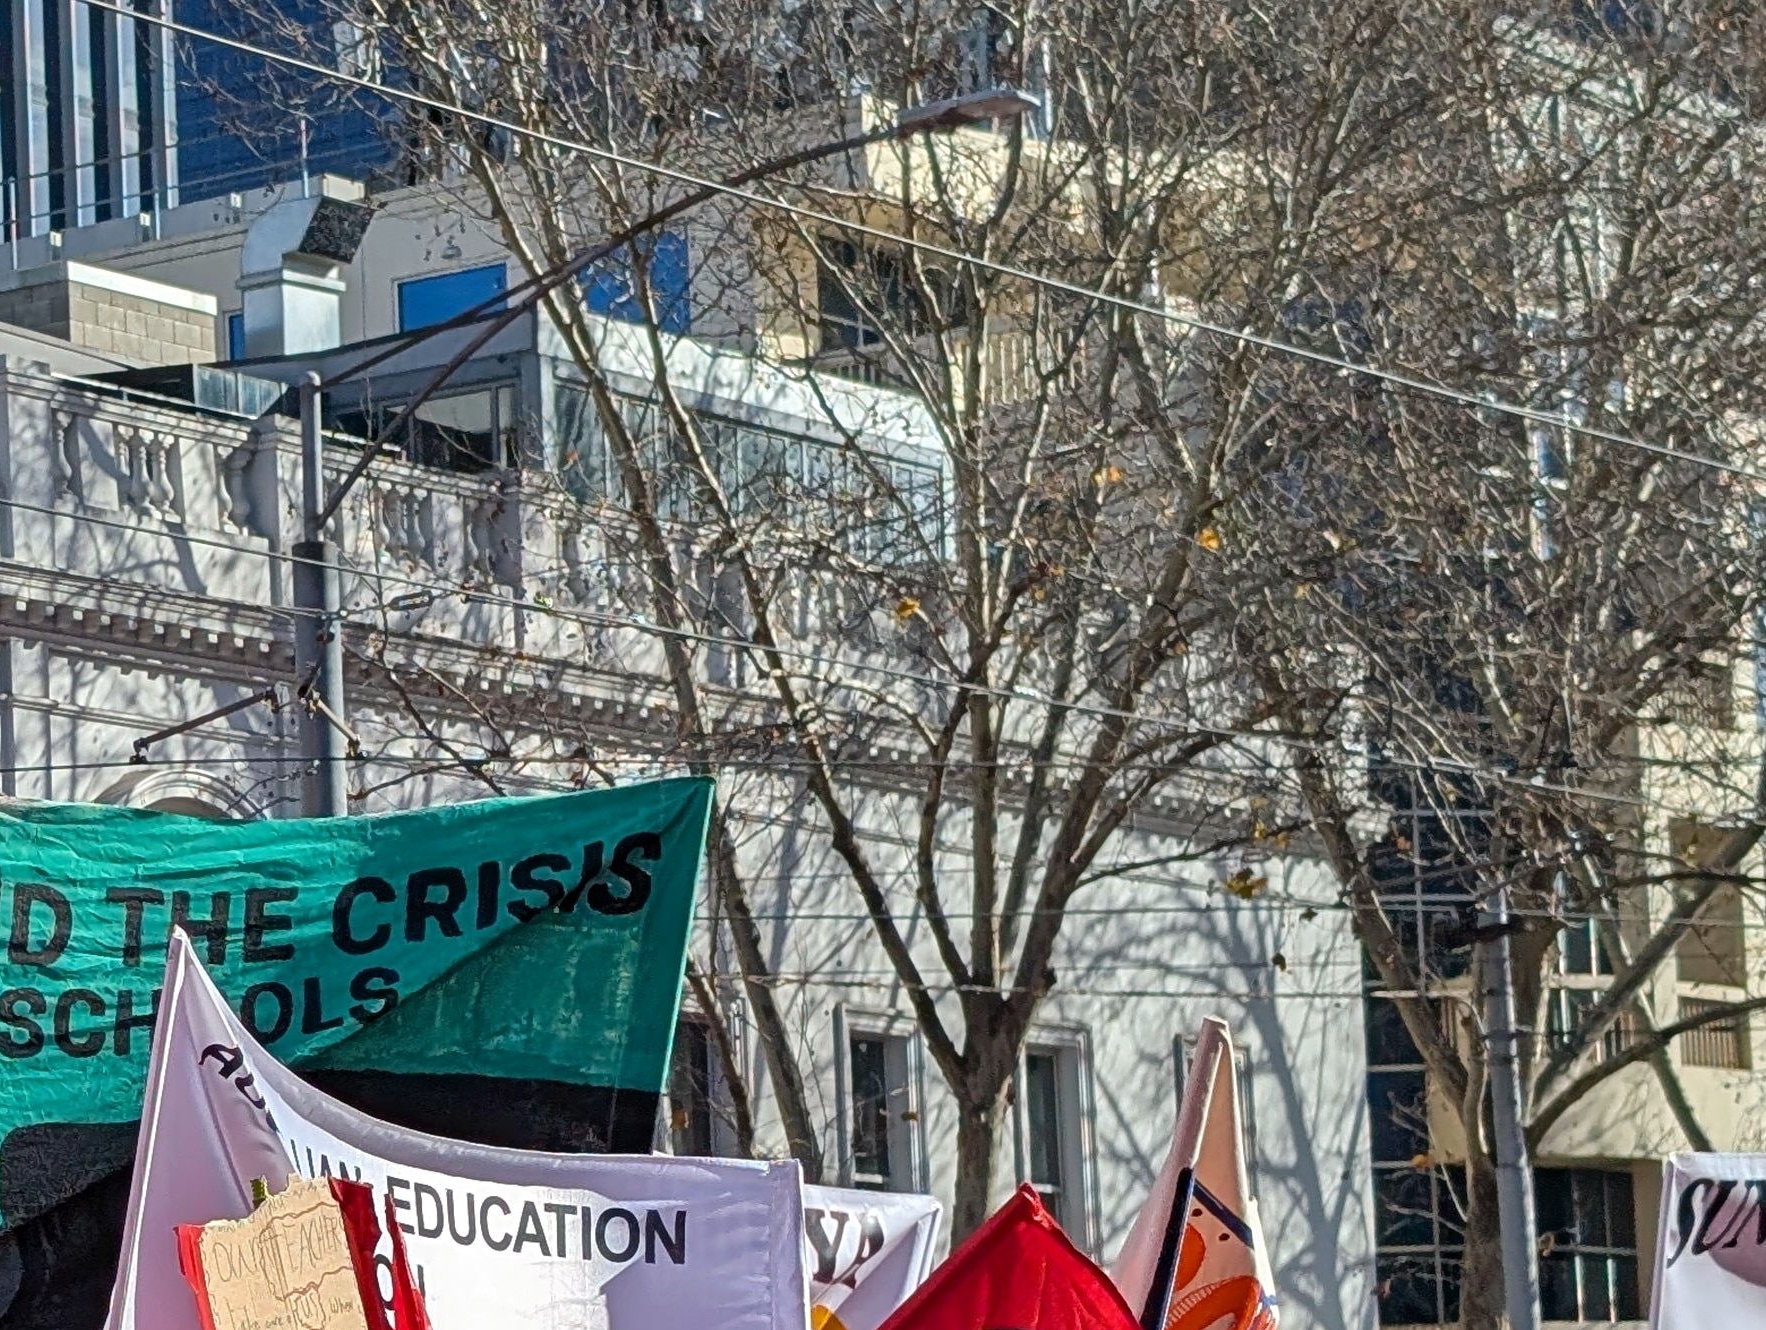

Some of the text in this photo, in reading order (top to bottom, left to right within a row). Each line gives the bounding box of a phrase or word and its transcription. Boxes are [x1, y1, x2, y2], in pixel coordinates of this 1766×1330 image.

[106, 885, 299, 966] THE
[332, 831, 662, 955] CRISIS
[386, 1174, 688, 1266] EDUCATION
